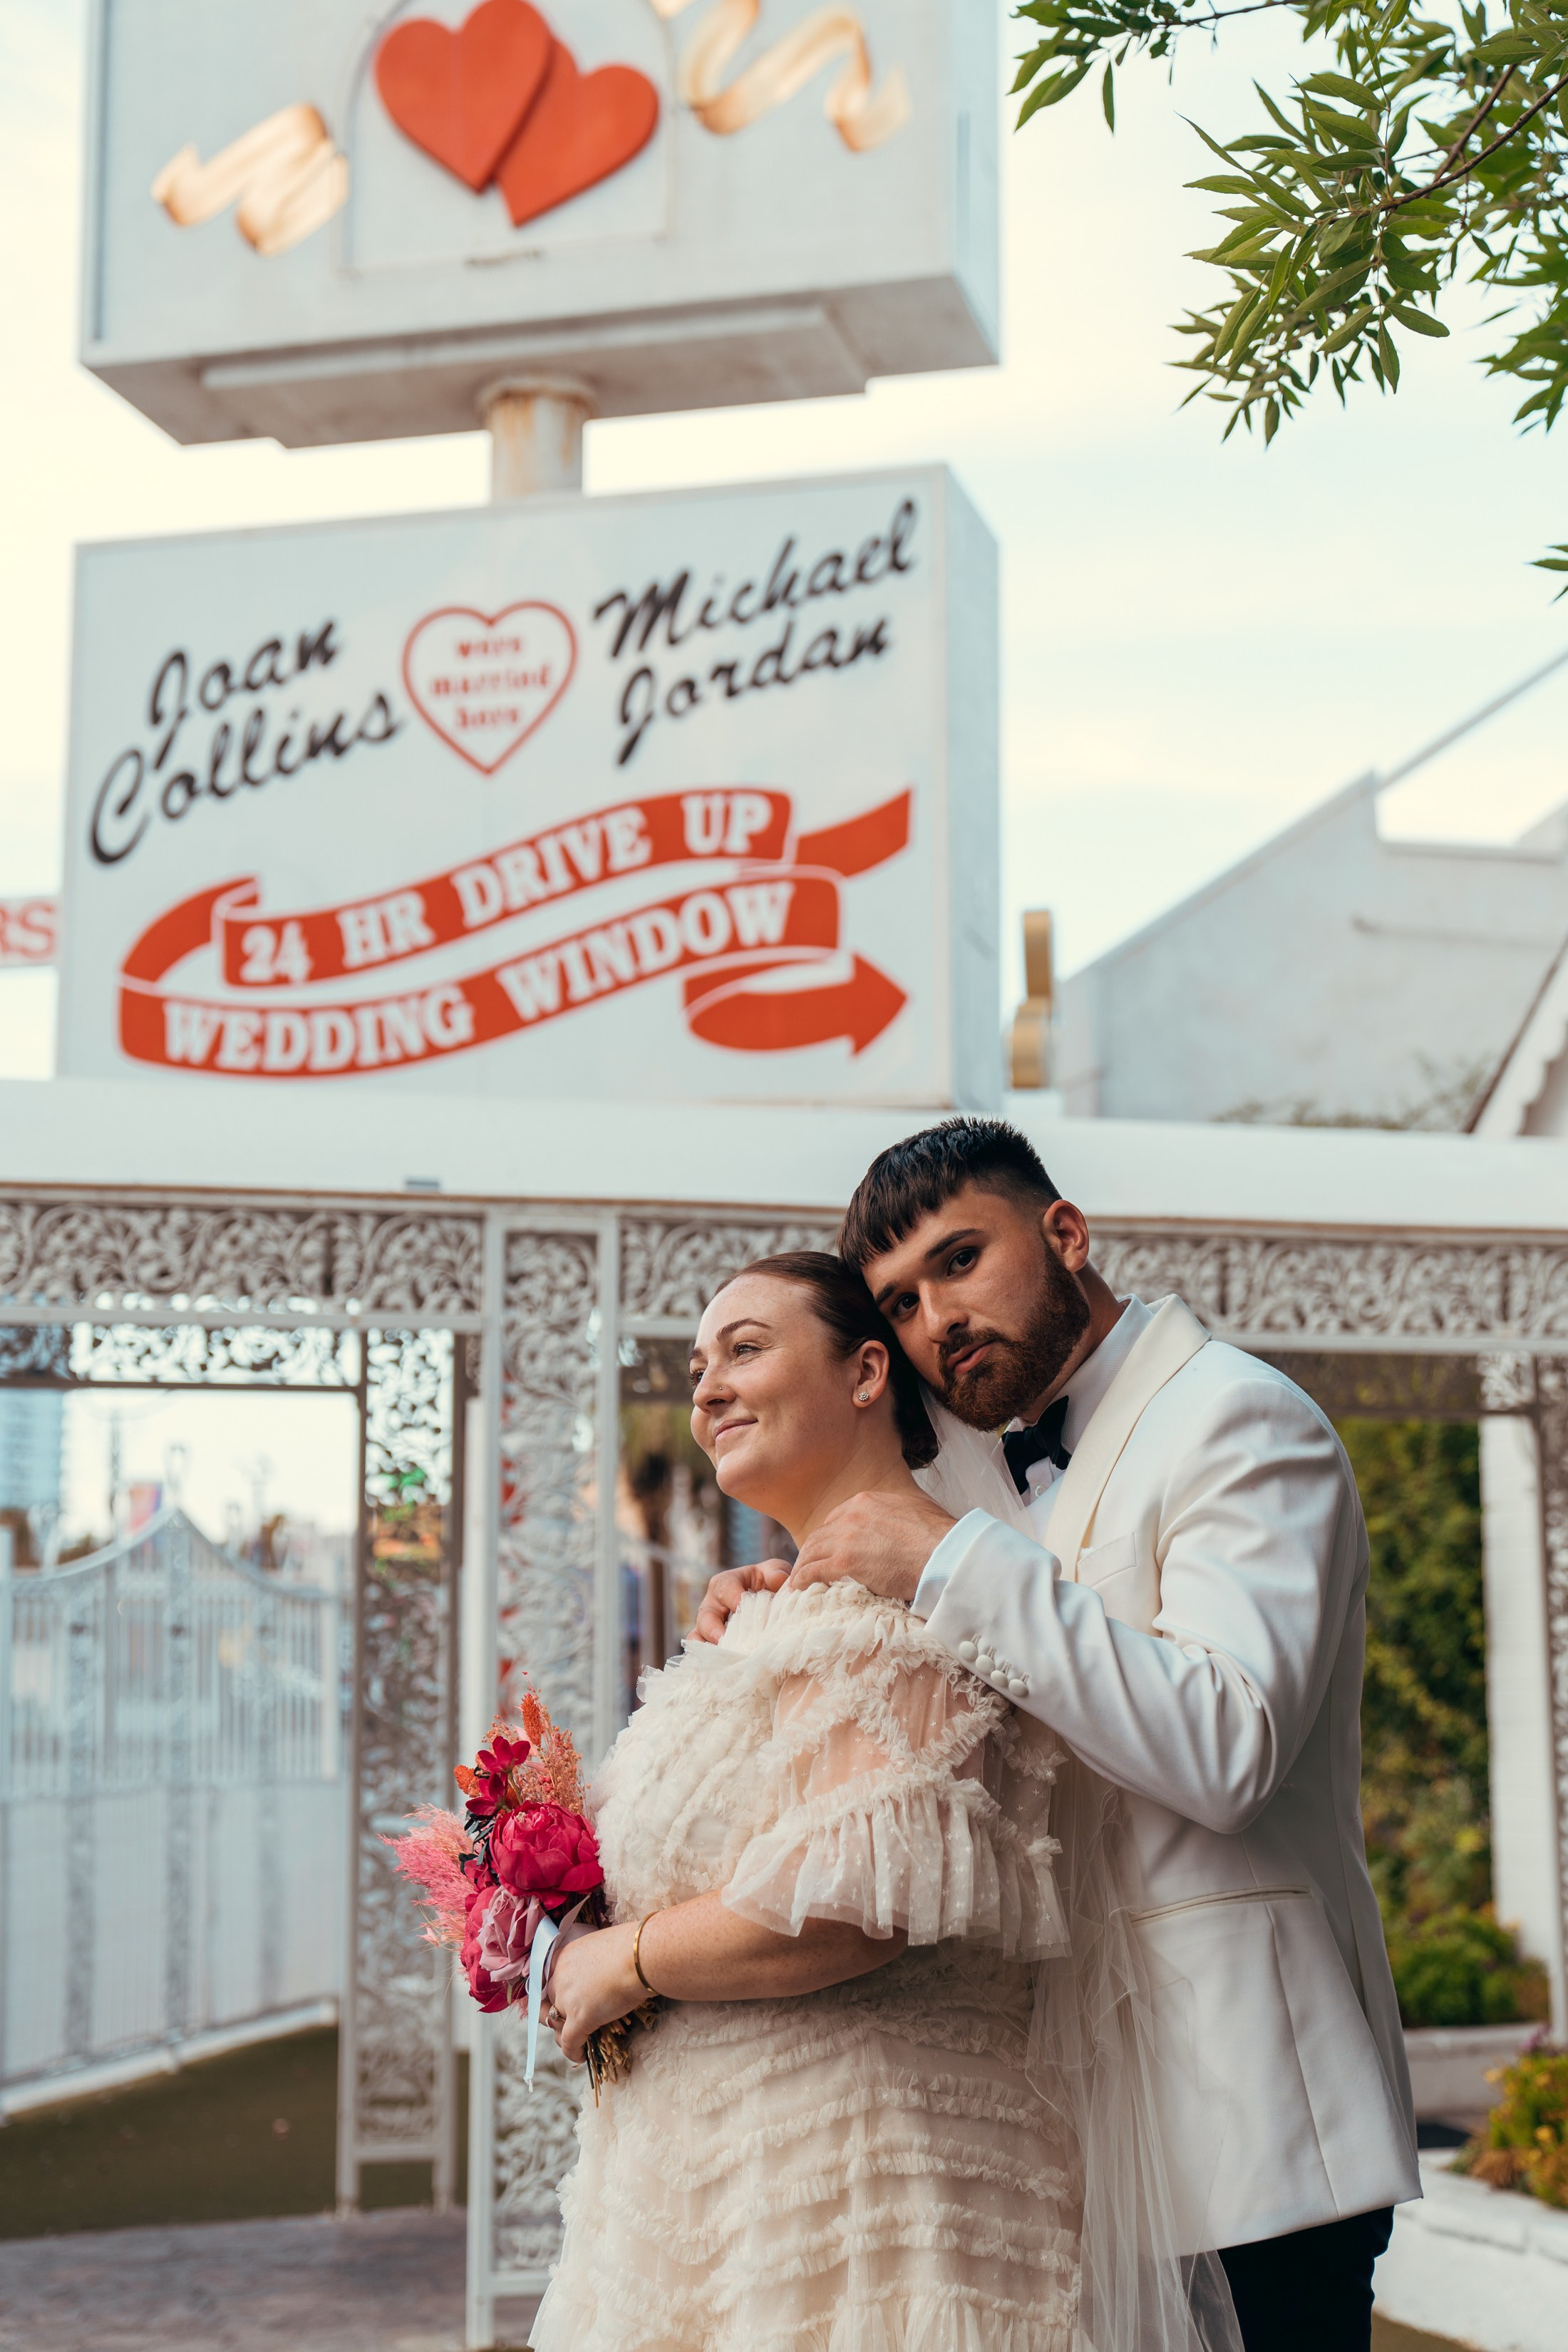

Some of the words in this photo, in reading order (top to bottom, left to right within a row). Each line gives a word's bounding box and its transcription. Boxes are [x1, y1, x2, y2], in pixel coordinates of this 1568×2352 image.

[593, 495, 919, 659] Michael
[148, 619, 340, 771] Joan
[617, 617, 890, 767] Jordan
[88, 693, 402, 865] Collins
[240, 924, 311, 984] 24
[336, 889, 435, 971] HR
[452, 805, 653, 929] DRIVE
[681, 791, 773, 855] UP
[164, 985, 476, 1073] WEDDING
[496, 882, 795, 1023] WINDOW
